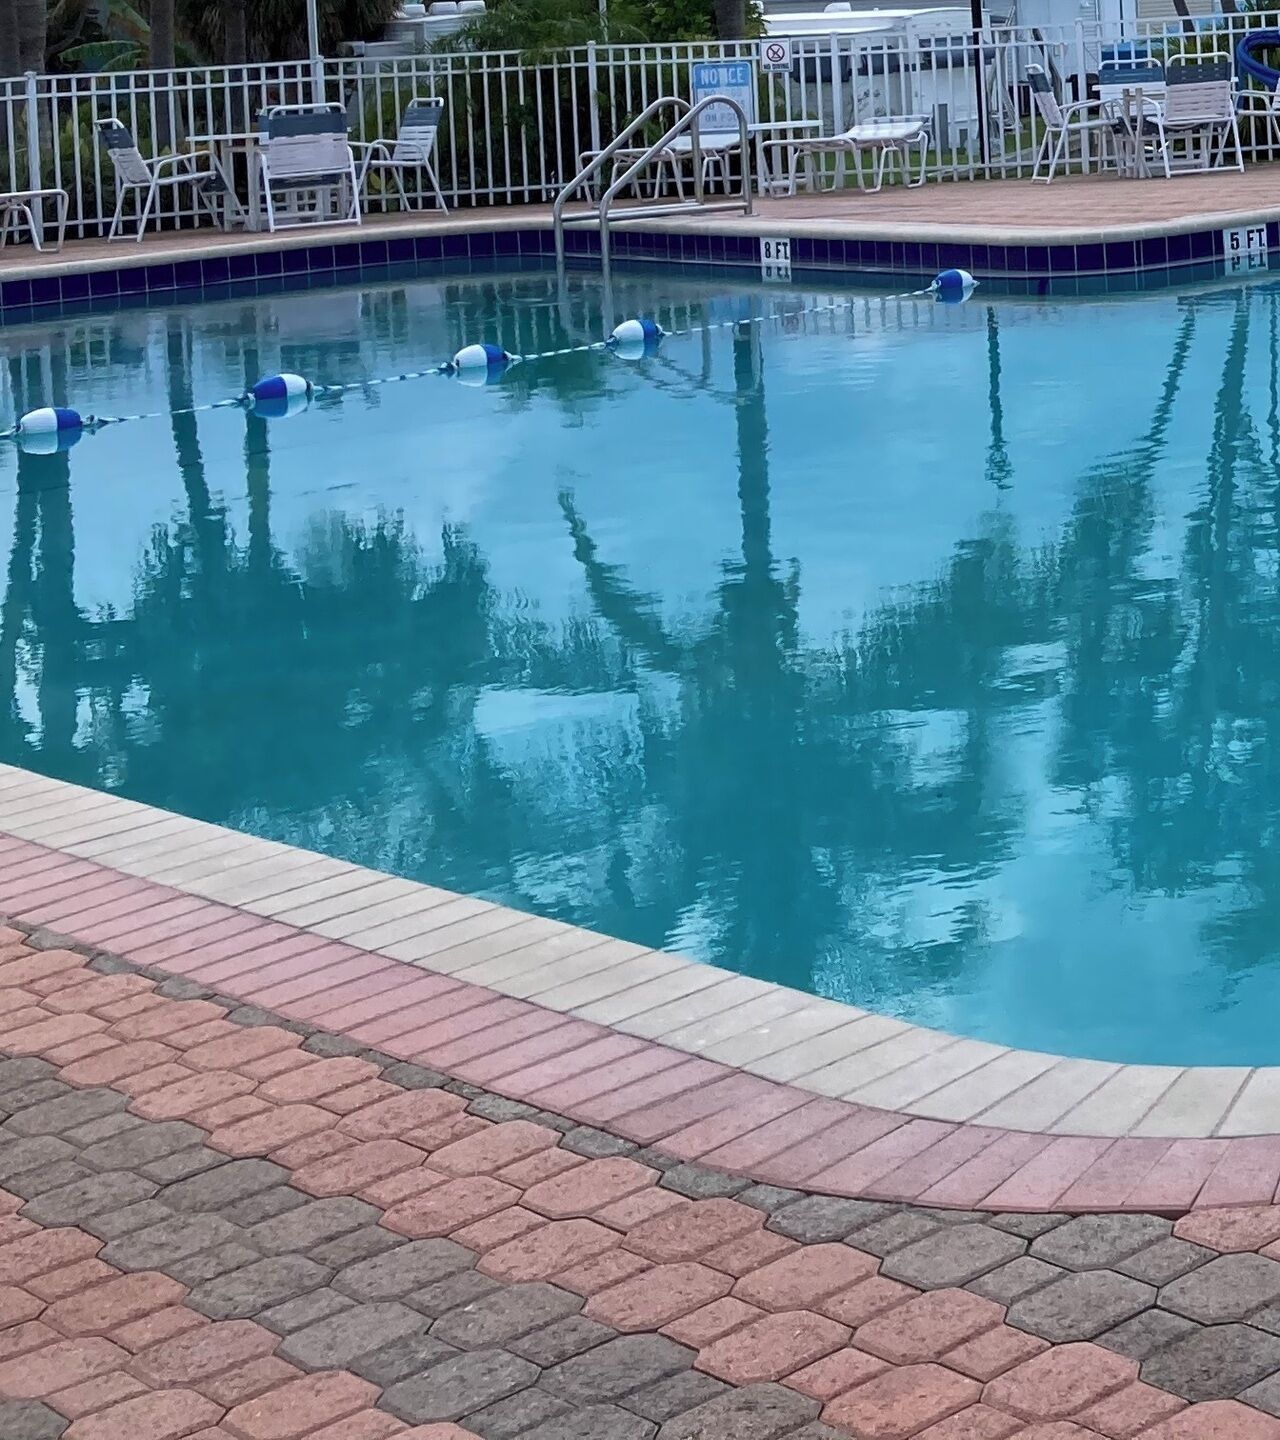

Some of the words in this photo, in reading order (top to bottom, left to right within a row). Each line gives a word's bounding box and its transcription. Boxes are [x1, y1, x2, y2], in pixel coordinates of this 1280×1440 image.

[701, 68, 744, 85] NOCE
[1230, 231, 1239, 250] 5
[765, 241, 771, 258] 8
